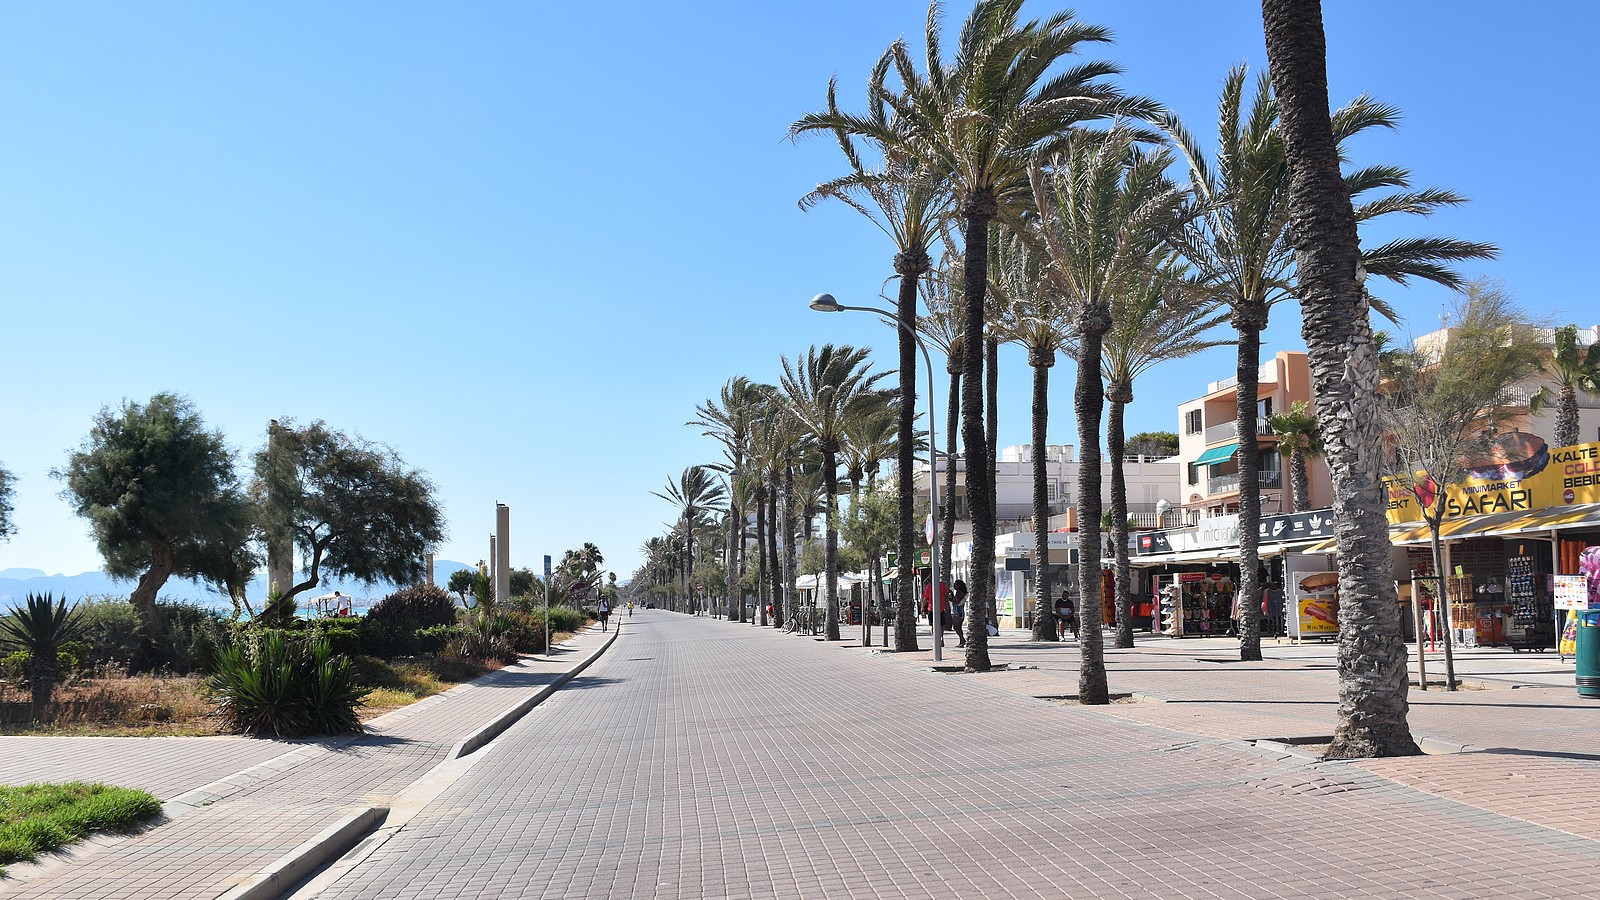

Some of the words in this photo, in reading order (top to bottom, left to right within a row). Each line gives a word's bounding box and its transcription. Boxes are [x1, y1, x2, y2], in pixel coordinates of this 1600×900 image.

[1552, 447, 1598, 464] KALTE
[1462, 480, 1521, 495] MINIMARKET
[1448, 488, 1532, 517] SAFARI
